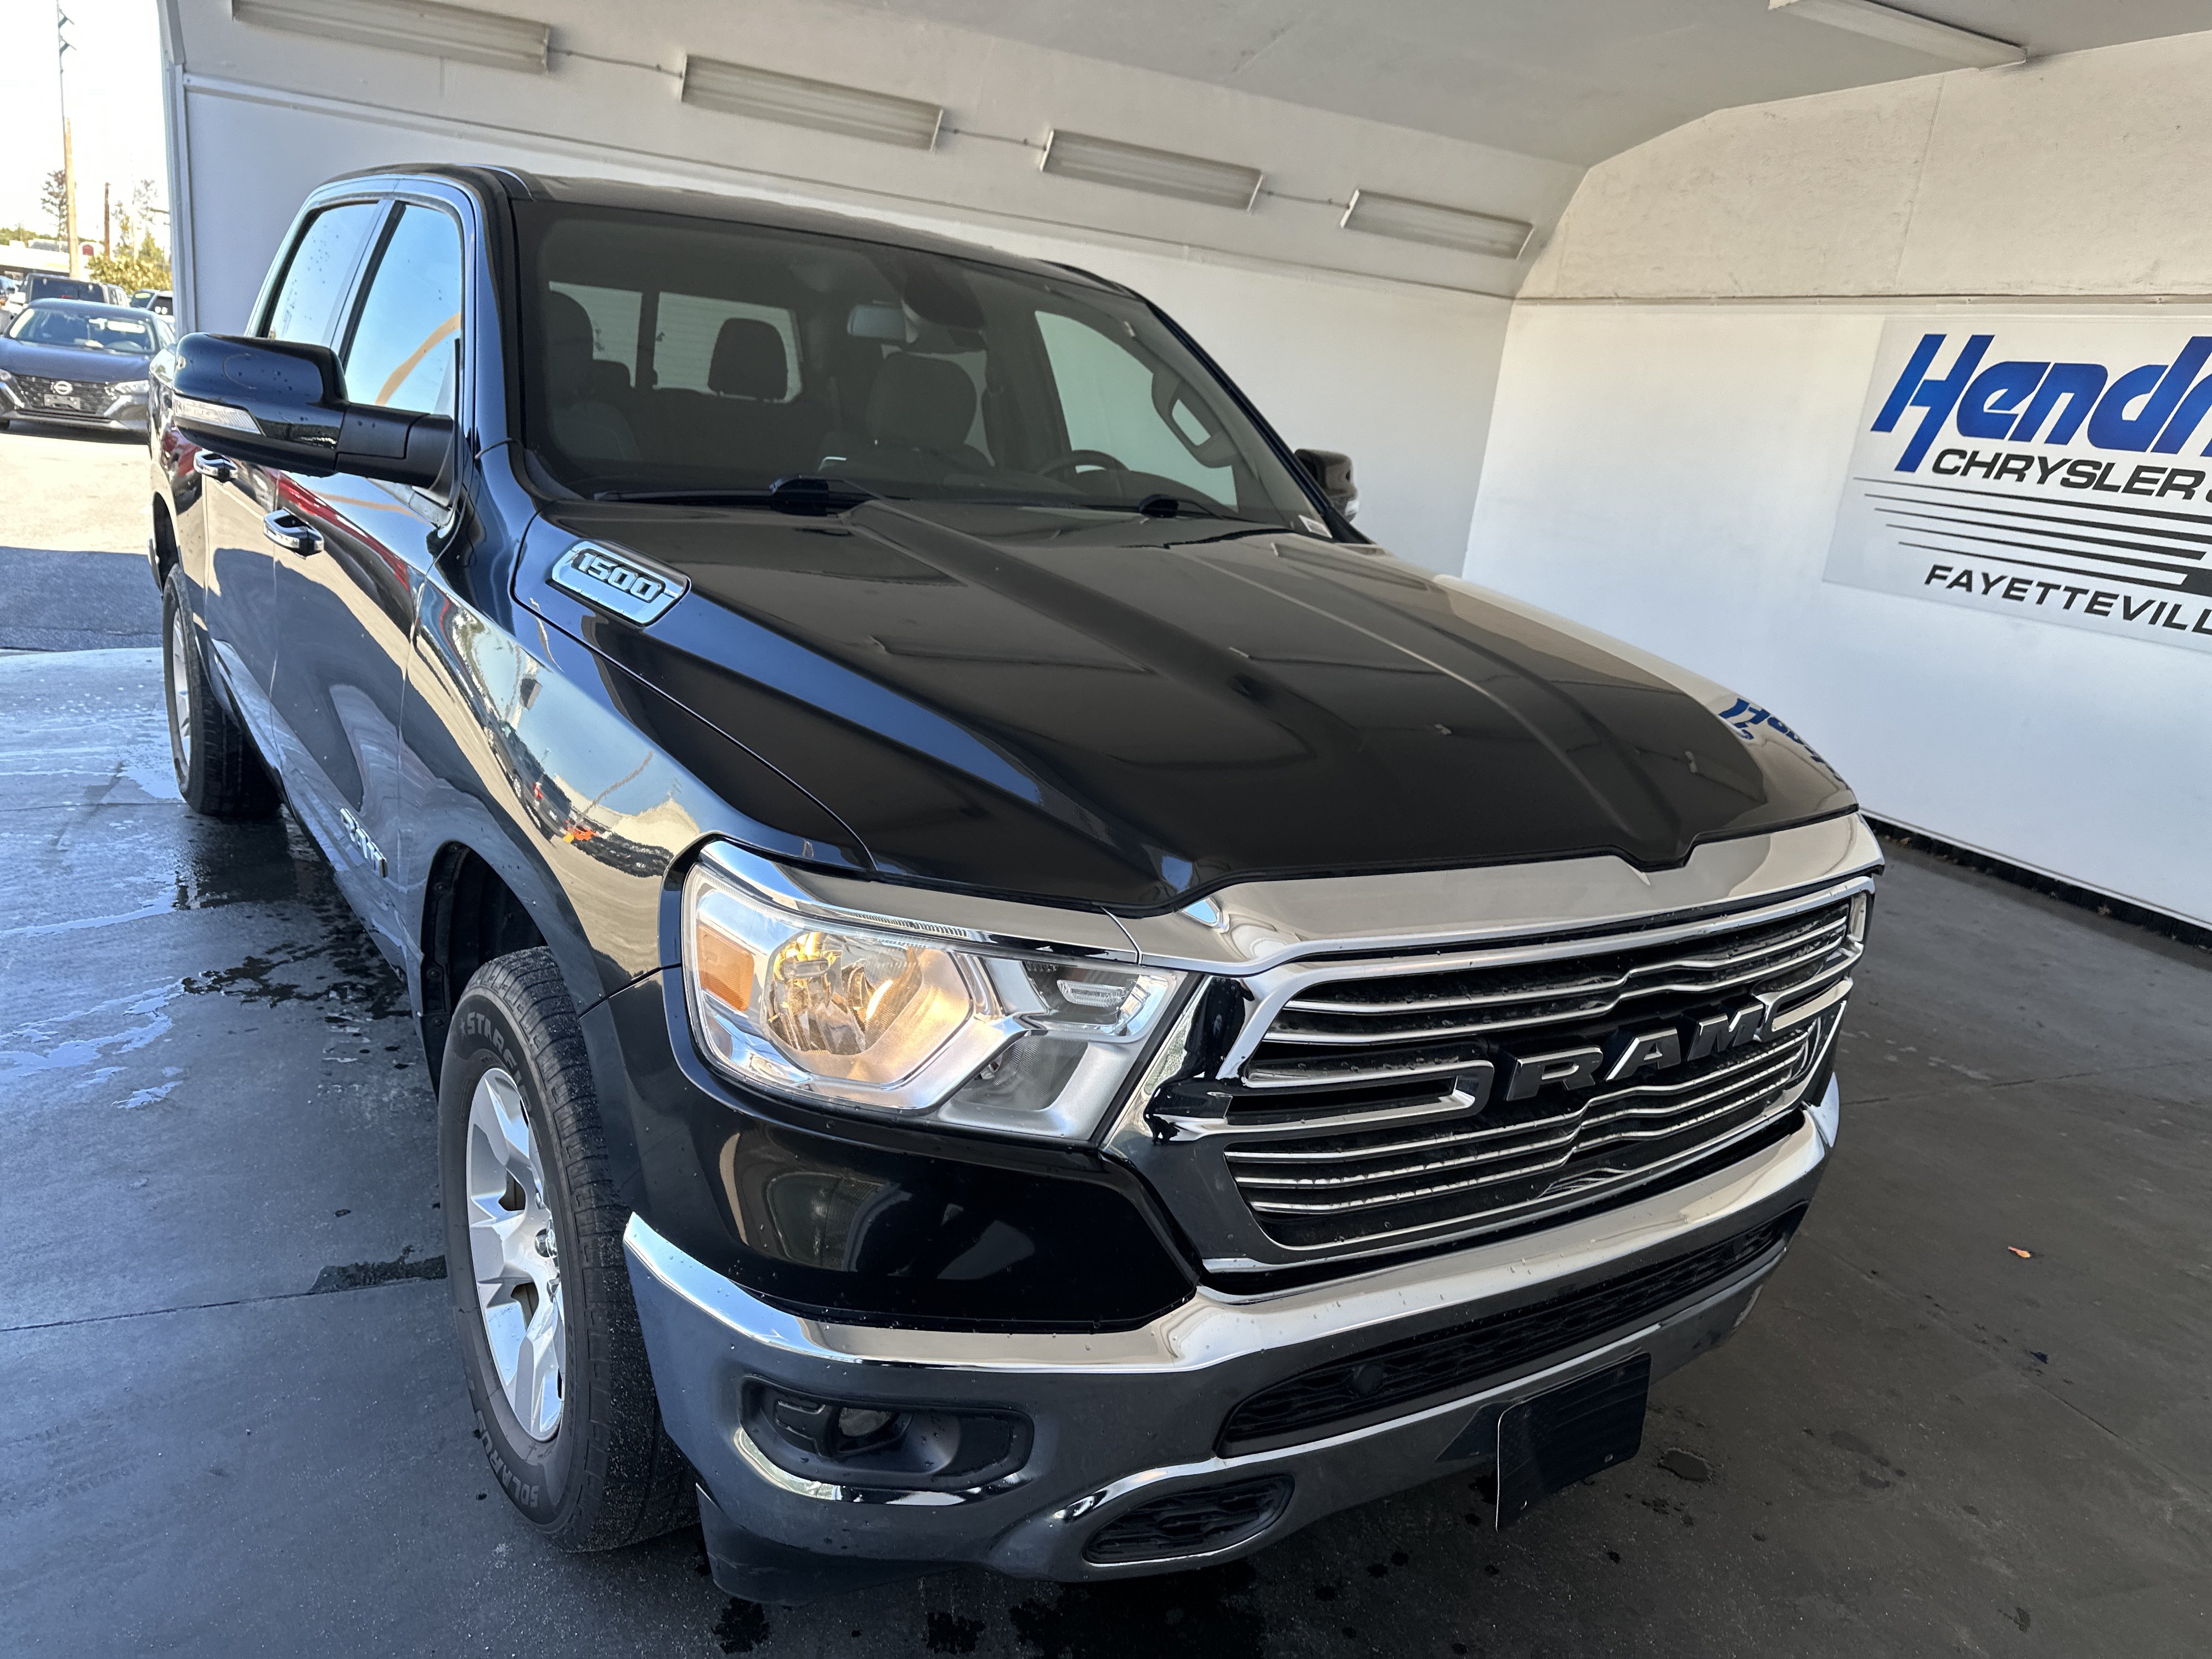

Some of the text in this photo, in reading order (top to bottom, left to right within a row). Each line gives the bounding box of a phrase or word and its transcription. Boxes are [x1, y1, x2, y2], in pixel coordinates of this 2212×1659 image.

[1870, 334, 2212, 472] Hendr
[1932, 448, 2206, 501] CHRYSLER
[578, 552, 662, 601] 1500
[1505, 1003, 1764, 1102] RAM
[476, 1410, 540, 1509] SOLARUS
